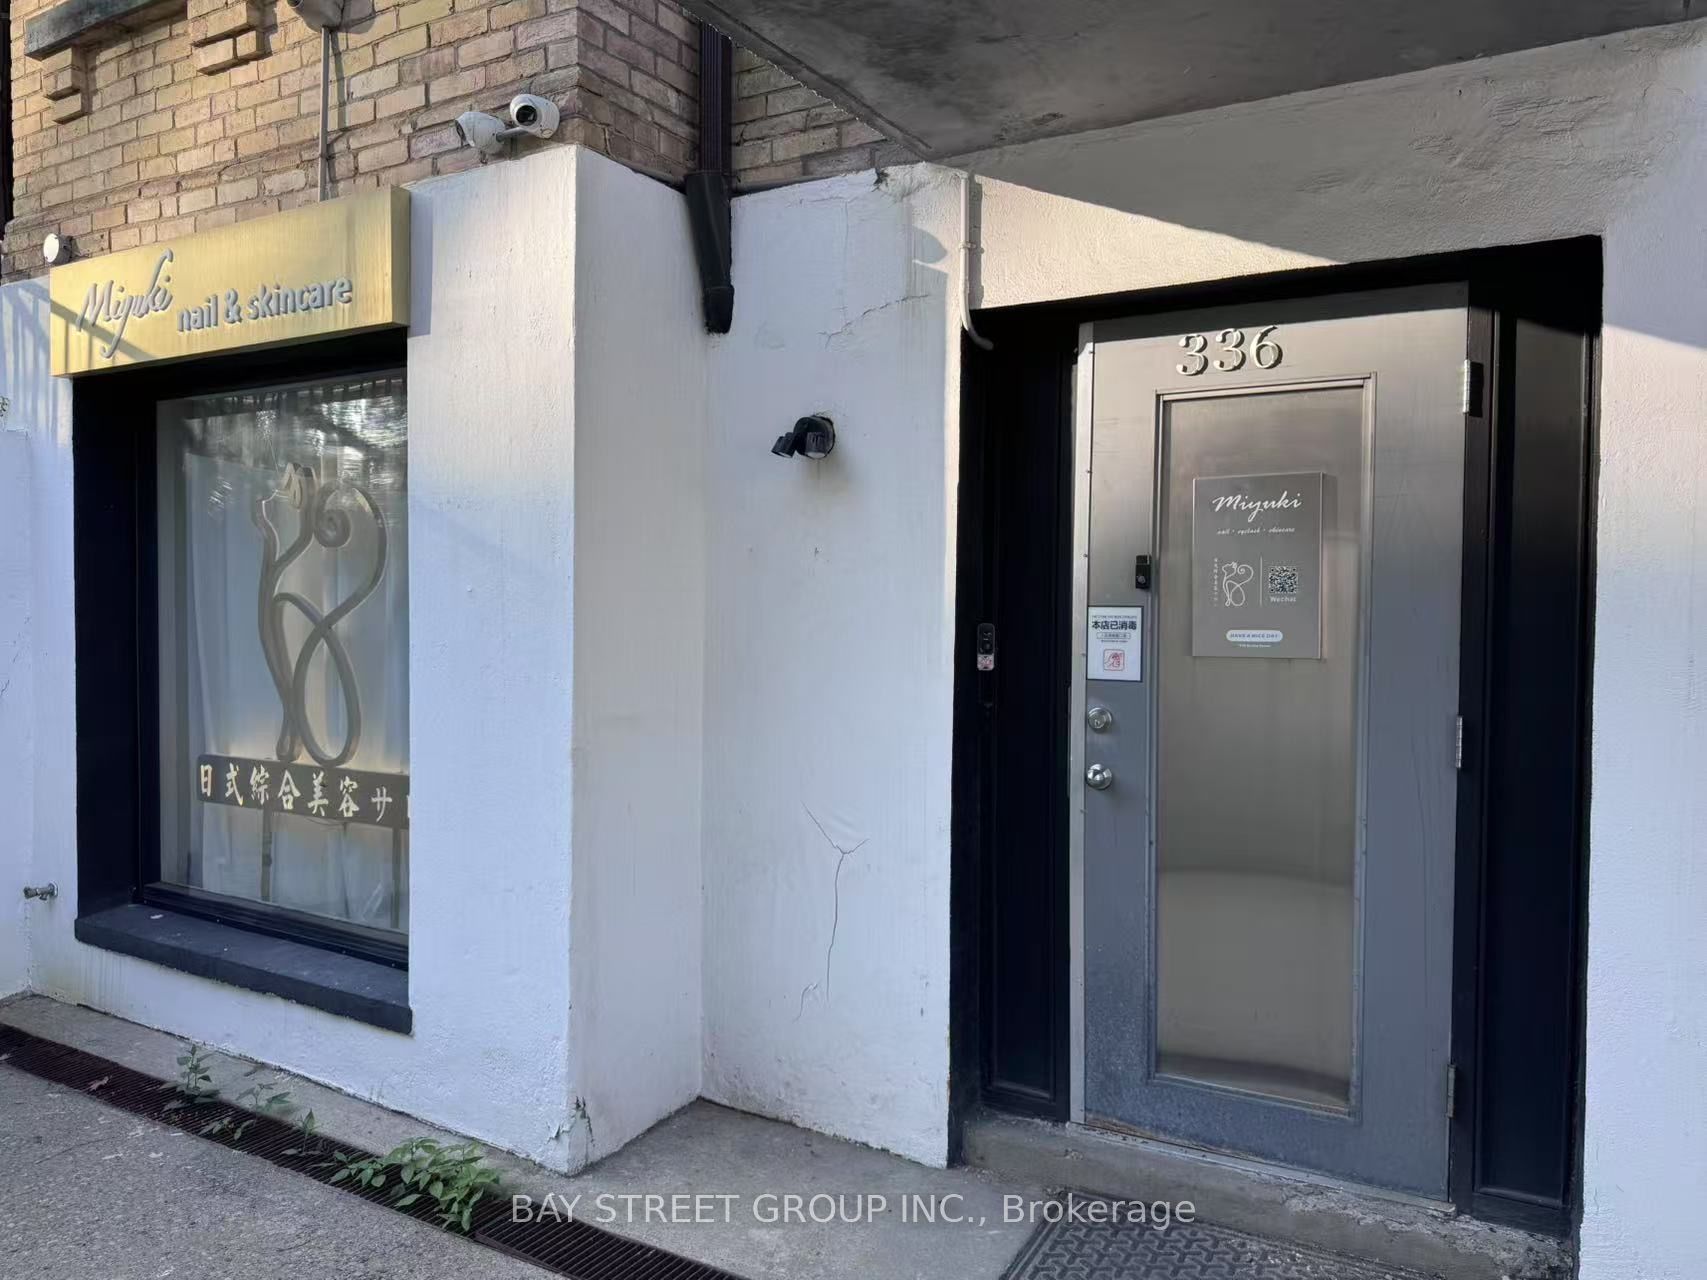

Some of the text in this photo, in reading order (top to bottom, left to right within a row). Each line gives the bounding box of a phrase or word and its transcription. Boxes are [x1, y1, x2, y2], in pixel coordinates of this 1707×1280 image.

[76, 249, 352, 358] Miyuki nail & skincare
[1175, 324, 1283, 376] 336
[1211, 490, 1302, 523] Miyuki
[1091, 620, 1137, 631] 本店已消毒
[200, 762, 411, 822] 日式綜合美容サ
